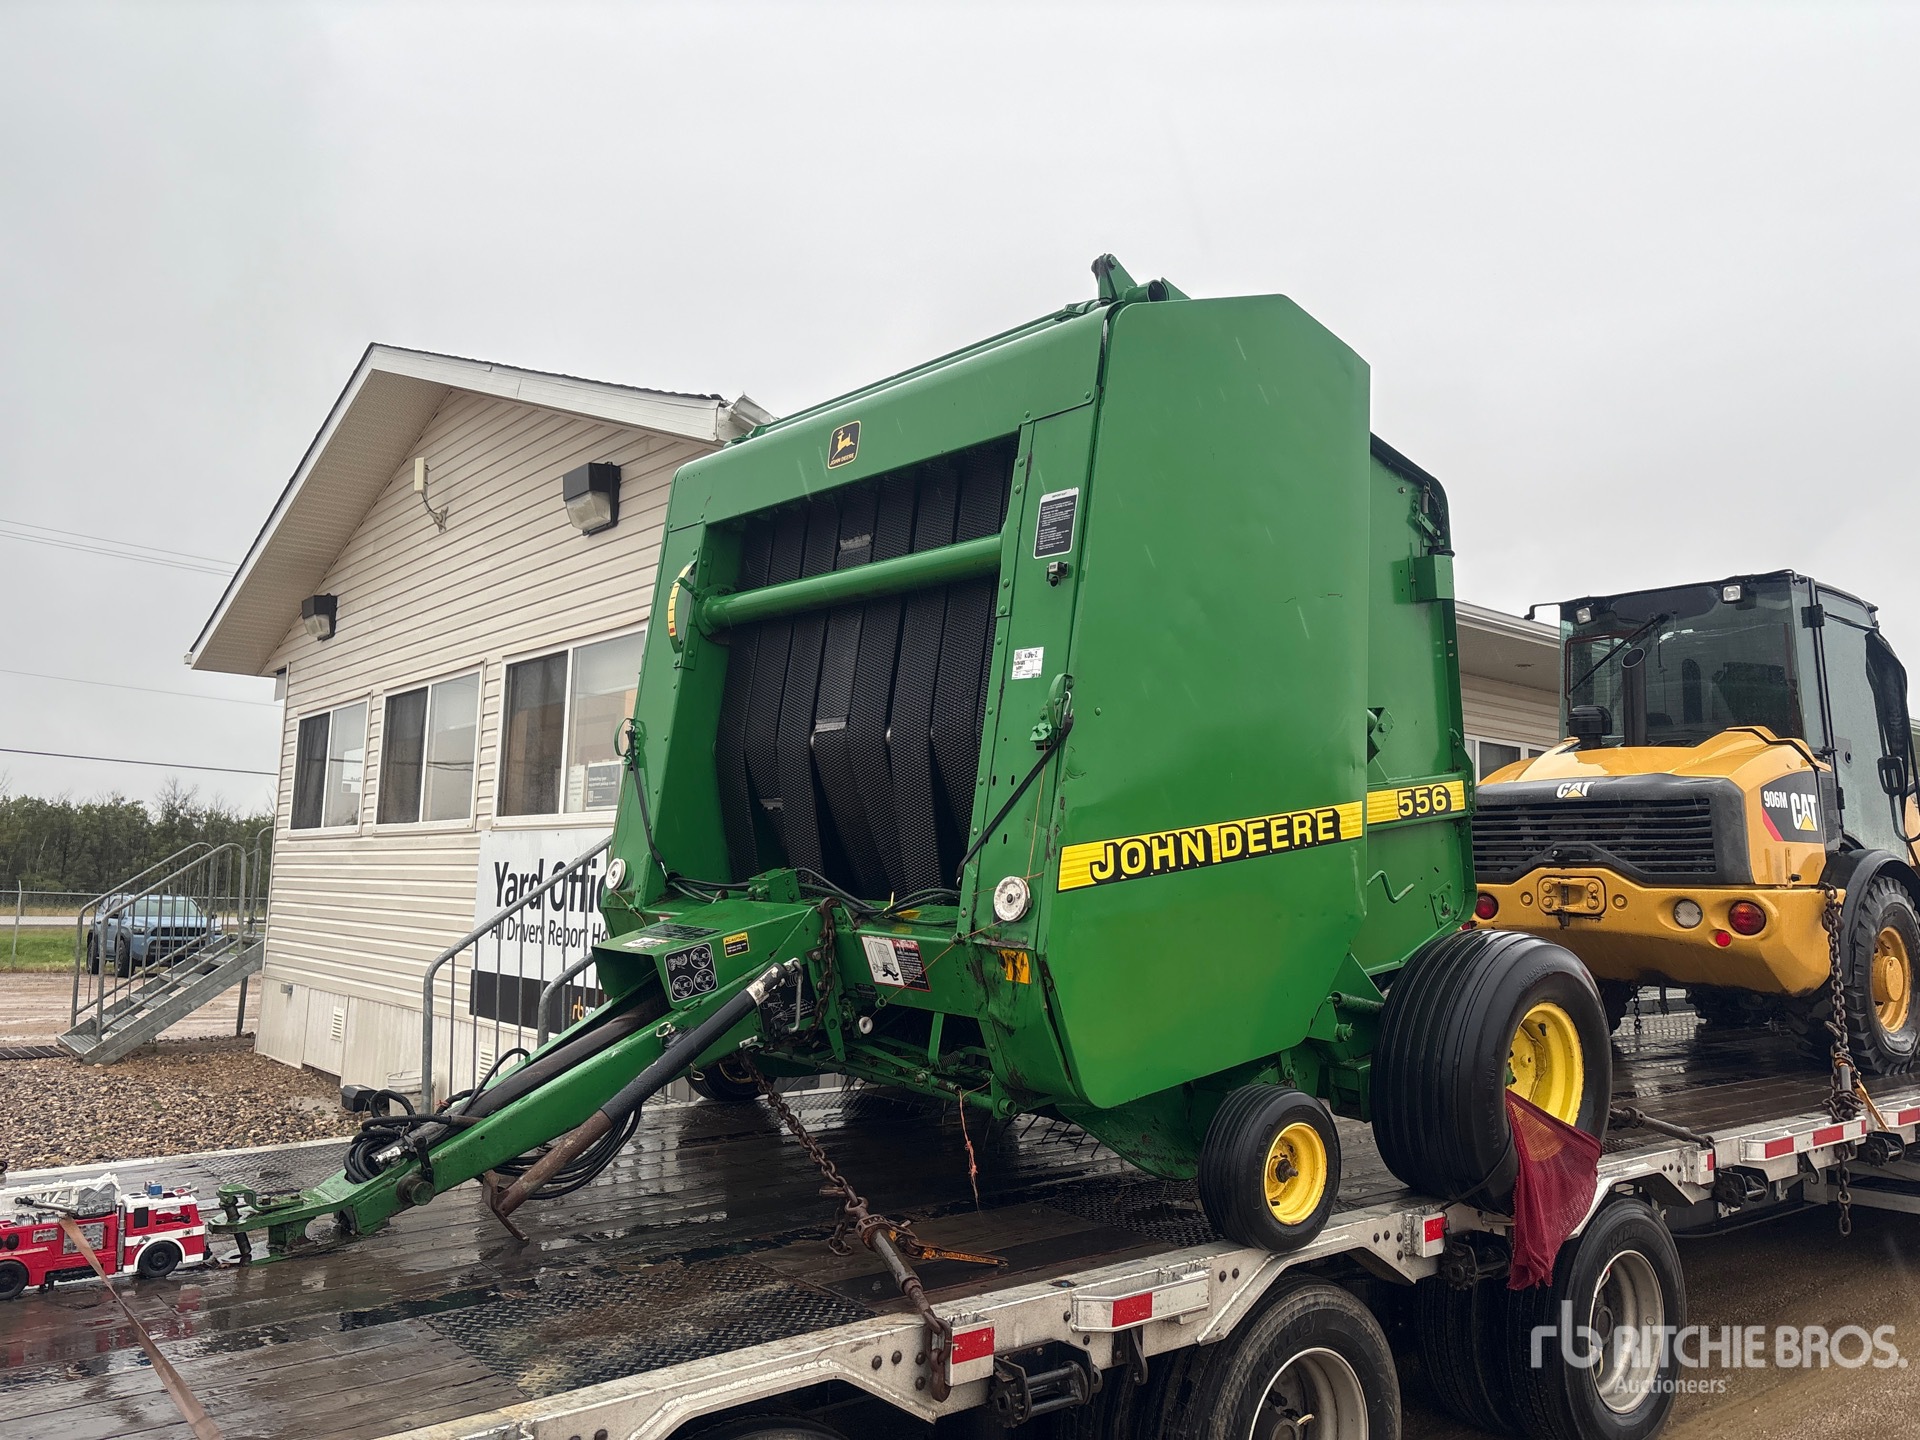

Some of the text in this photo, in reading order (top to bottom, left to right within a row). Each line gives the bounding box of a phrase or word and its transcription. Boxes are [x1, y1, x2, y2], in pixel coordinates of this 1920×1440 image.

[1398, 786, 1447, 817] 556
[1556, 781, 1596, 798] CAT
[1763, 790, 1818, 831] 906M CAT
[1091, 810, 1336, 881] JOHN DEERE
[494, 858, 607, 914] Yard Offic
[490, 919, 505, 941] Al
[507, 916, 545, 945] Drver
